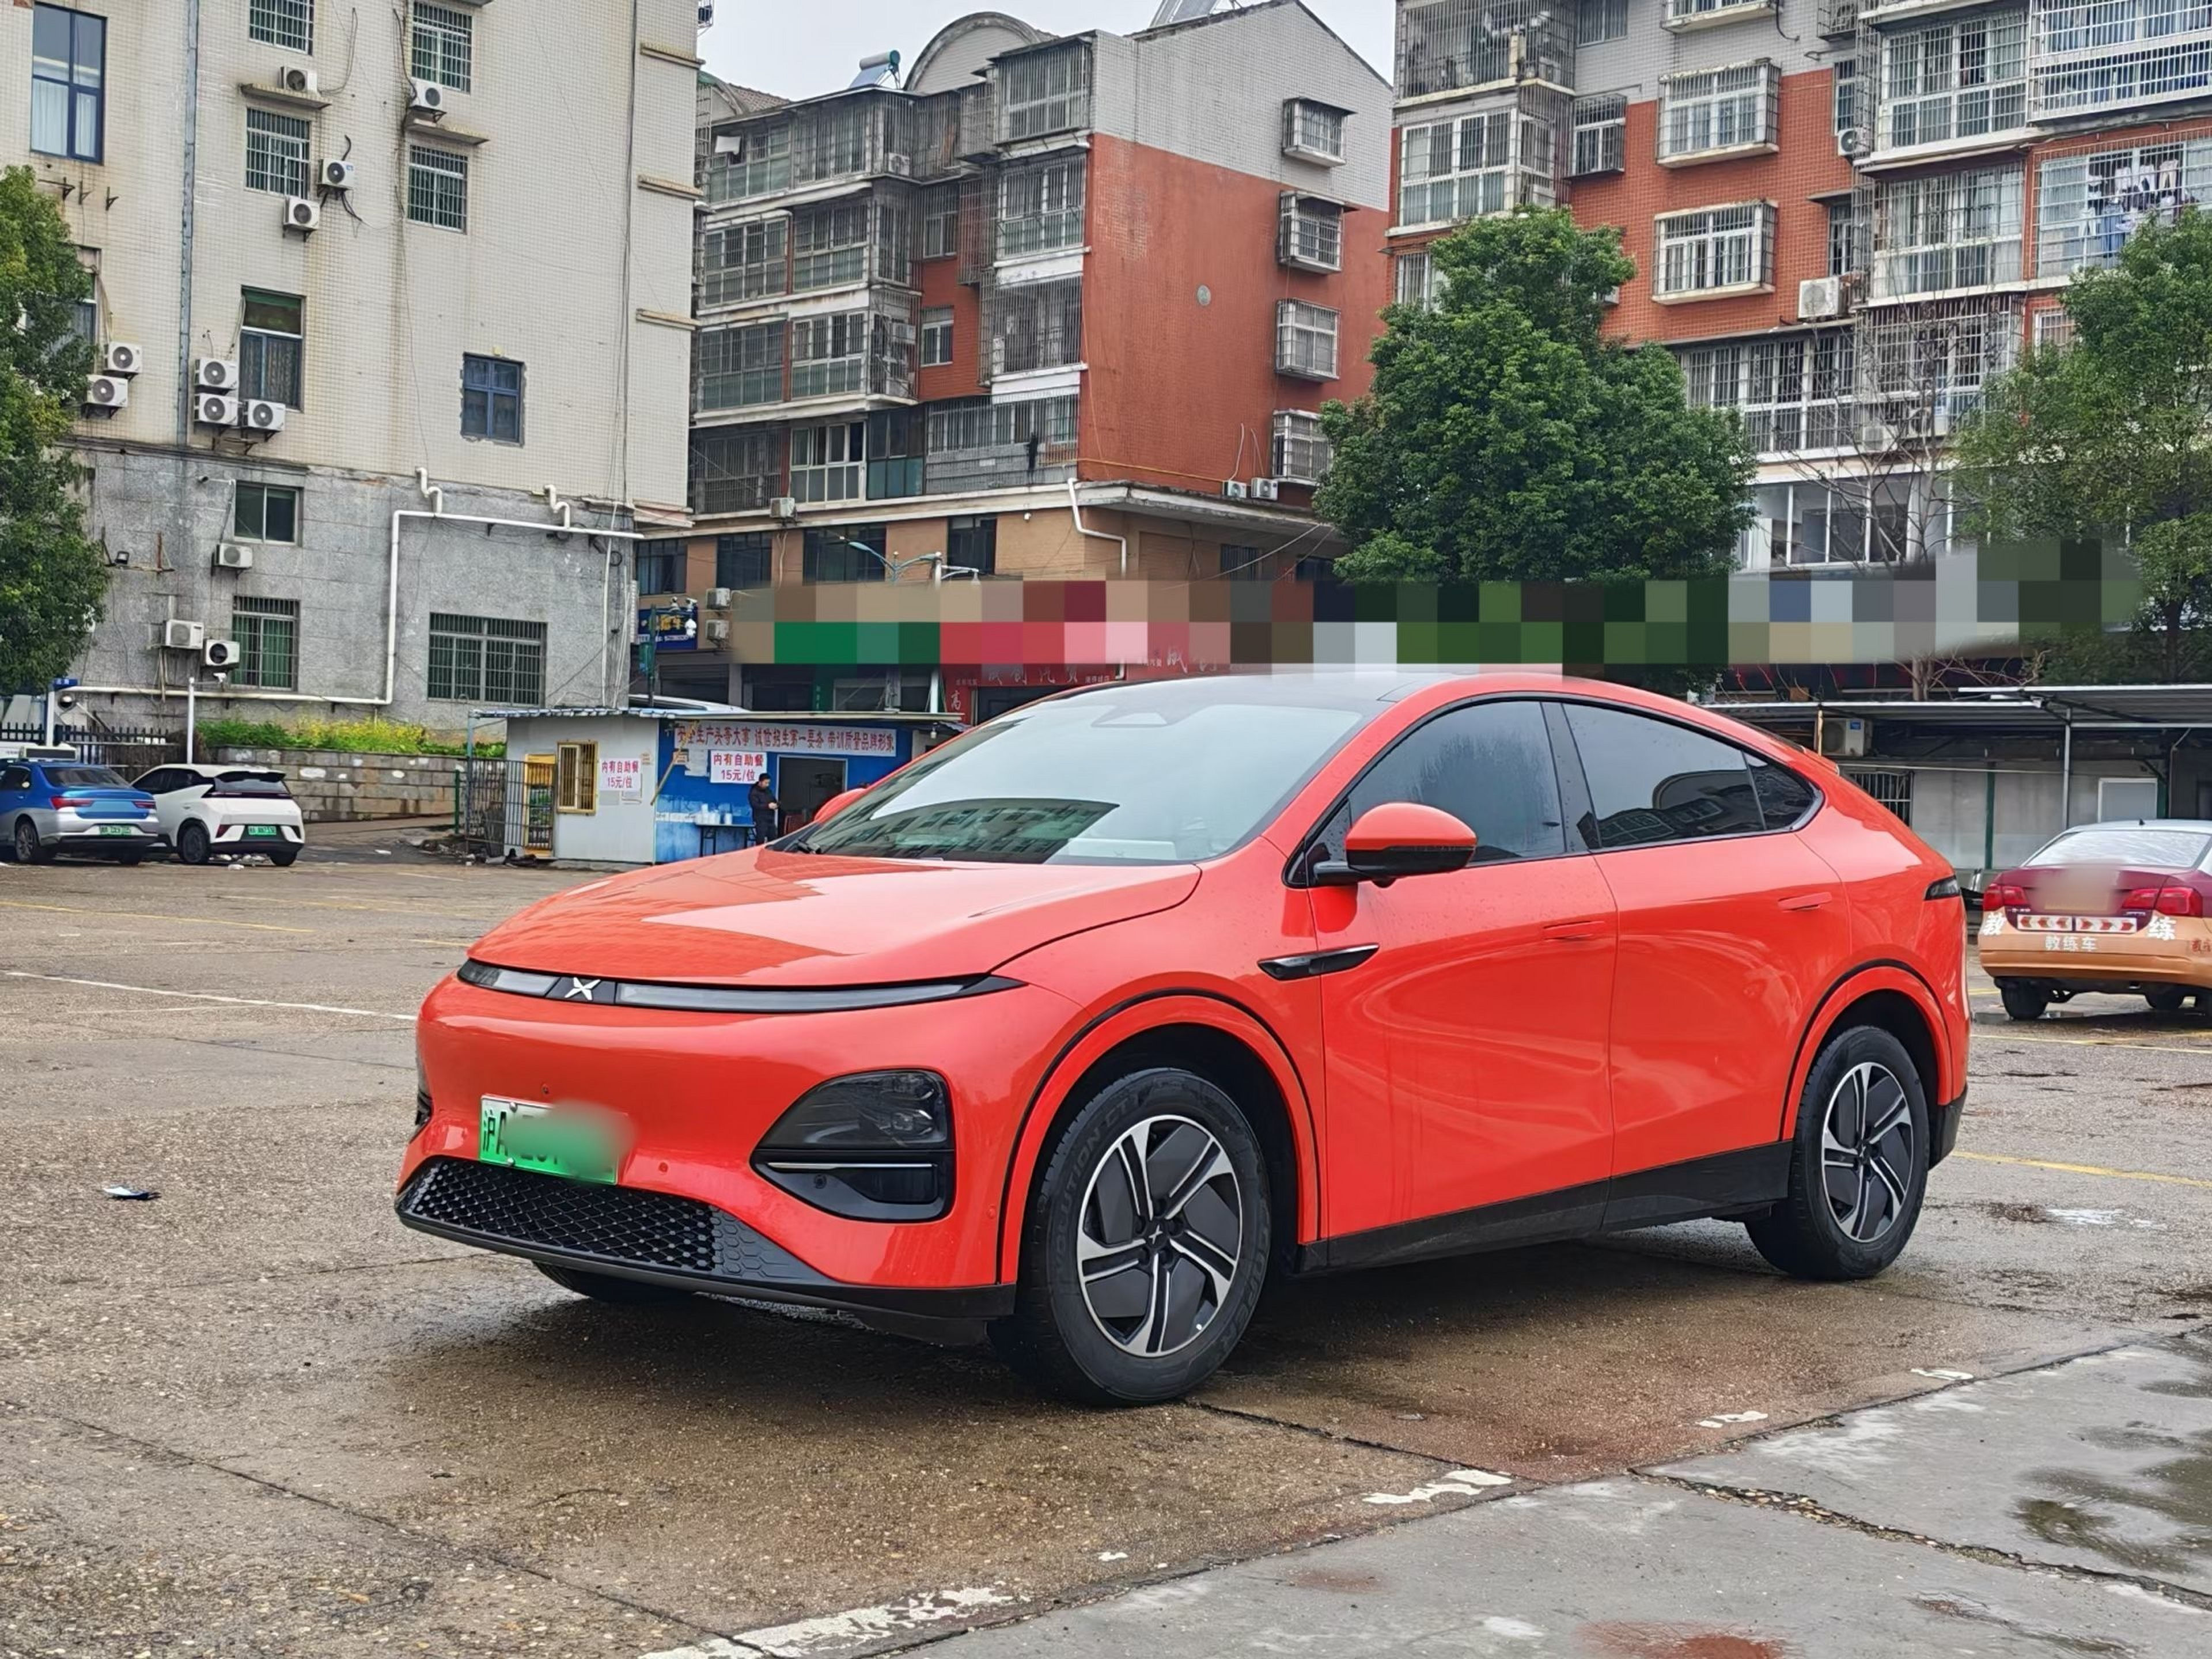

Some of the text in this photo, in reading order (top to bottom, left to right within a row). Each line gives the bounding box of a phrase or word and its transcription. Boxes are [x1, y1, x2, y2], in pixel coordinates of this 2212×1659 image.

[601, 760, 639, 773] 内有自助餐
[714, 753, 763, 767] 内有自助餐
[608, 776, 632, 788] 15元/位
[721, 769, 755, 781] 15元/位
[2147, 915, 2177, 941] 练
[2045, 935, 2098, 952] 教练车
[1054, 1126, 1103, 1283] VOLUTION
